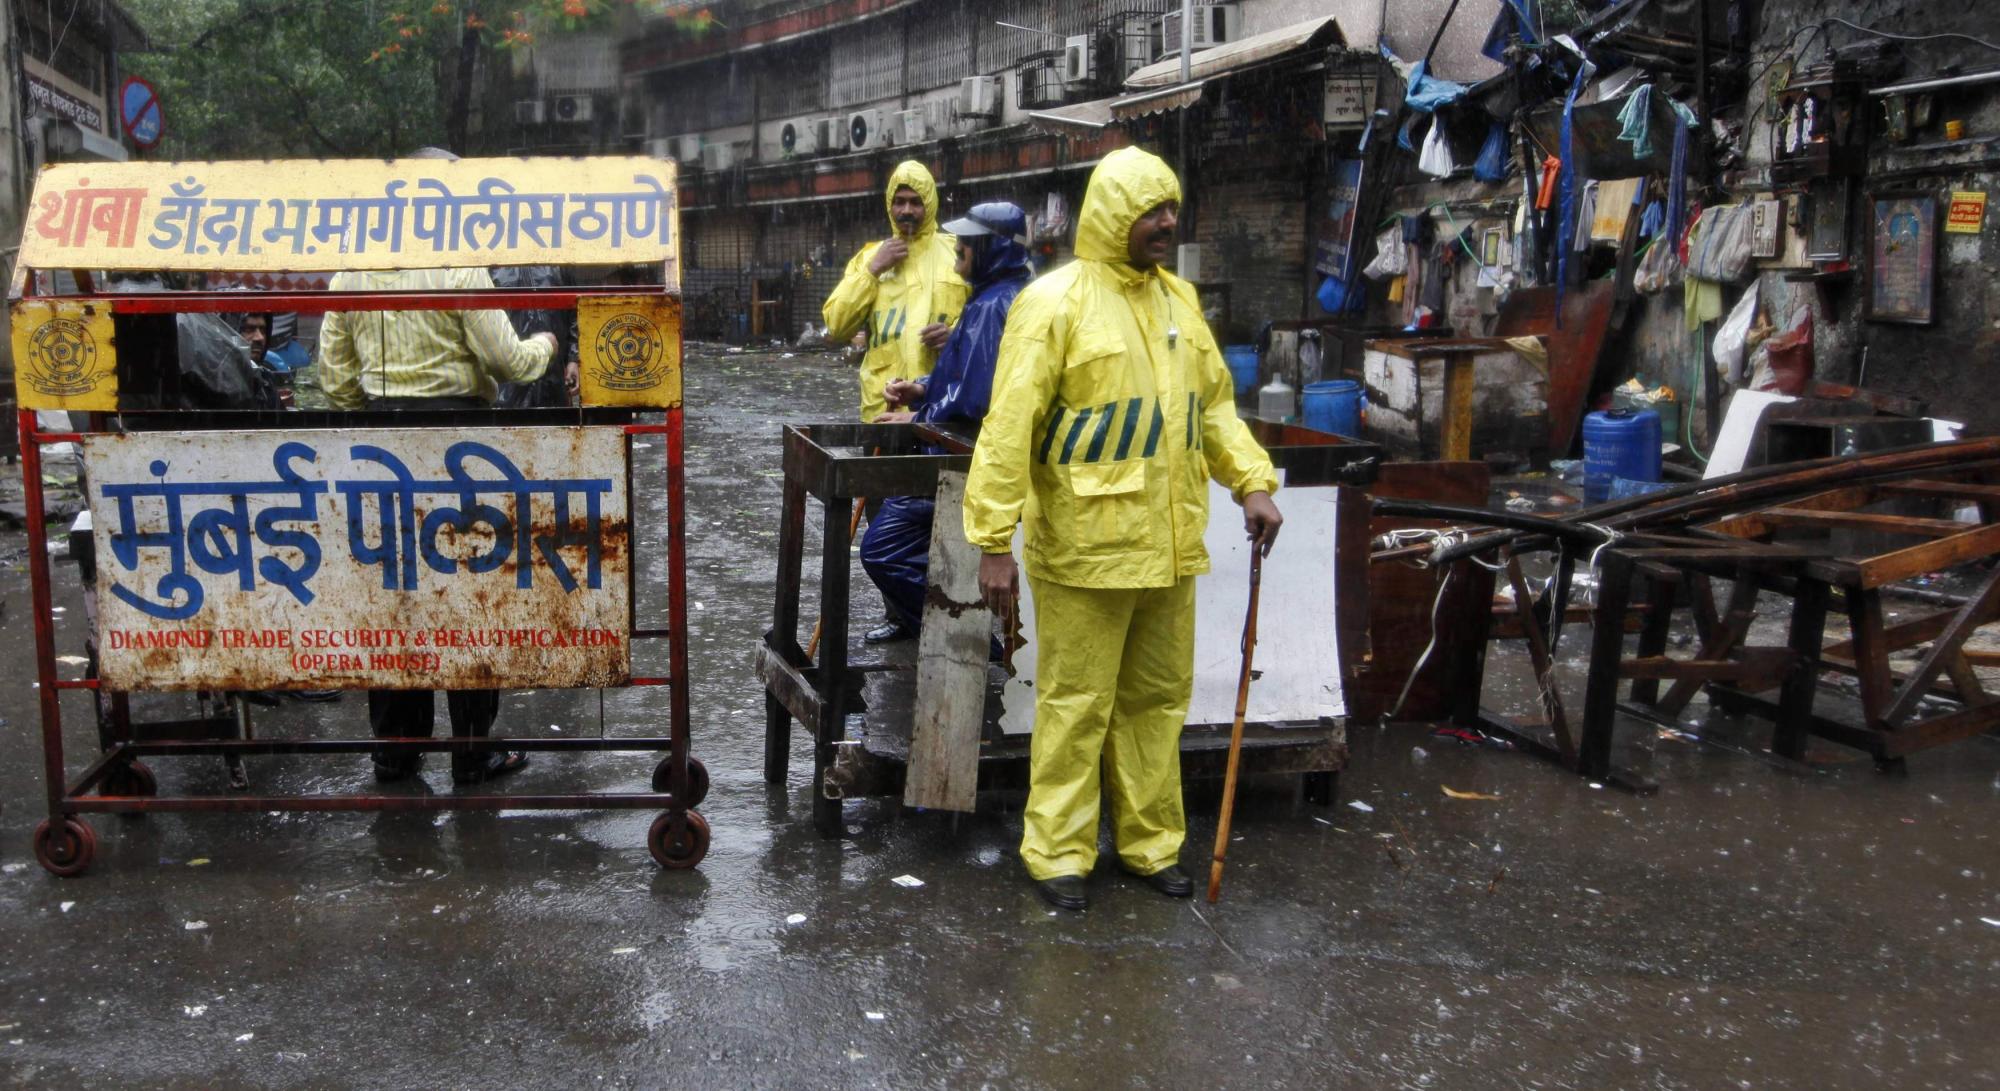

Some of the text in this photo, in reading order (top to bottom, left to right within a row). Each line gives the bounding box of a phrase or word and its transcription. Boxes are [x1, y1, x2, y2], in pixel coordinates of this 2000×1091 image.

[35, 177, 149, 248] थांबा
[411, 177, 566, 251] पोलीस
[567, 174, 671, 248] ठाणे
[102, 441, 613, 620] मुंबई पोलीस
[110, 630, 212, 649] DIAMOND
[219, 629, 292, 649] TRADE
[300, 629, 408, 648] SECURITY
[413, 629, 428, 648] &
[291, 652, 441, 673] (OPERA HOUSE)
